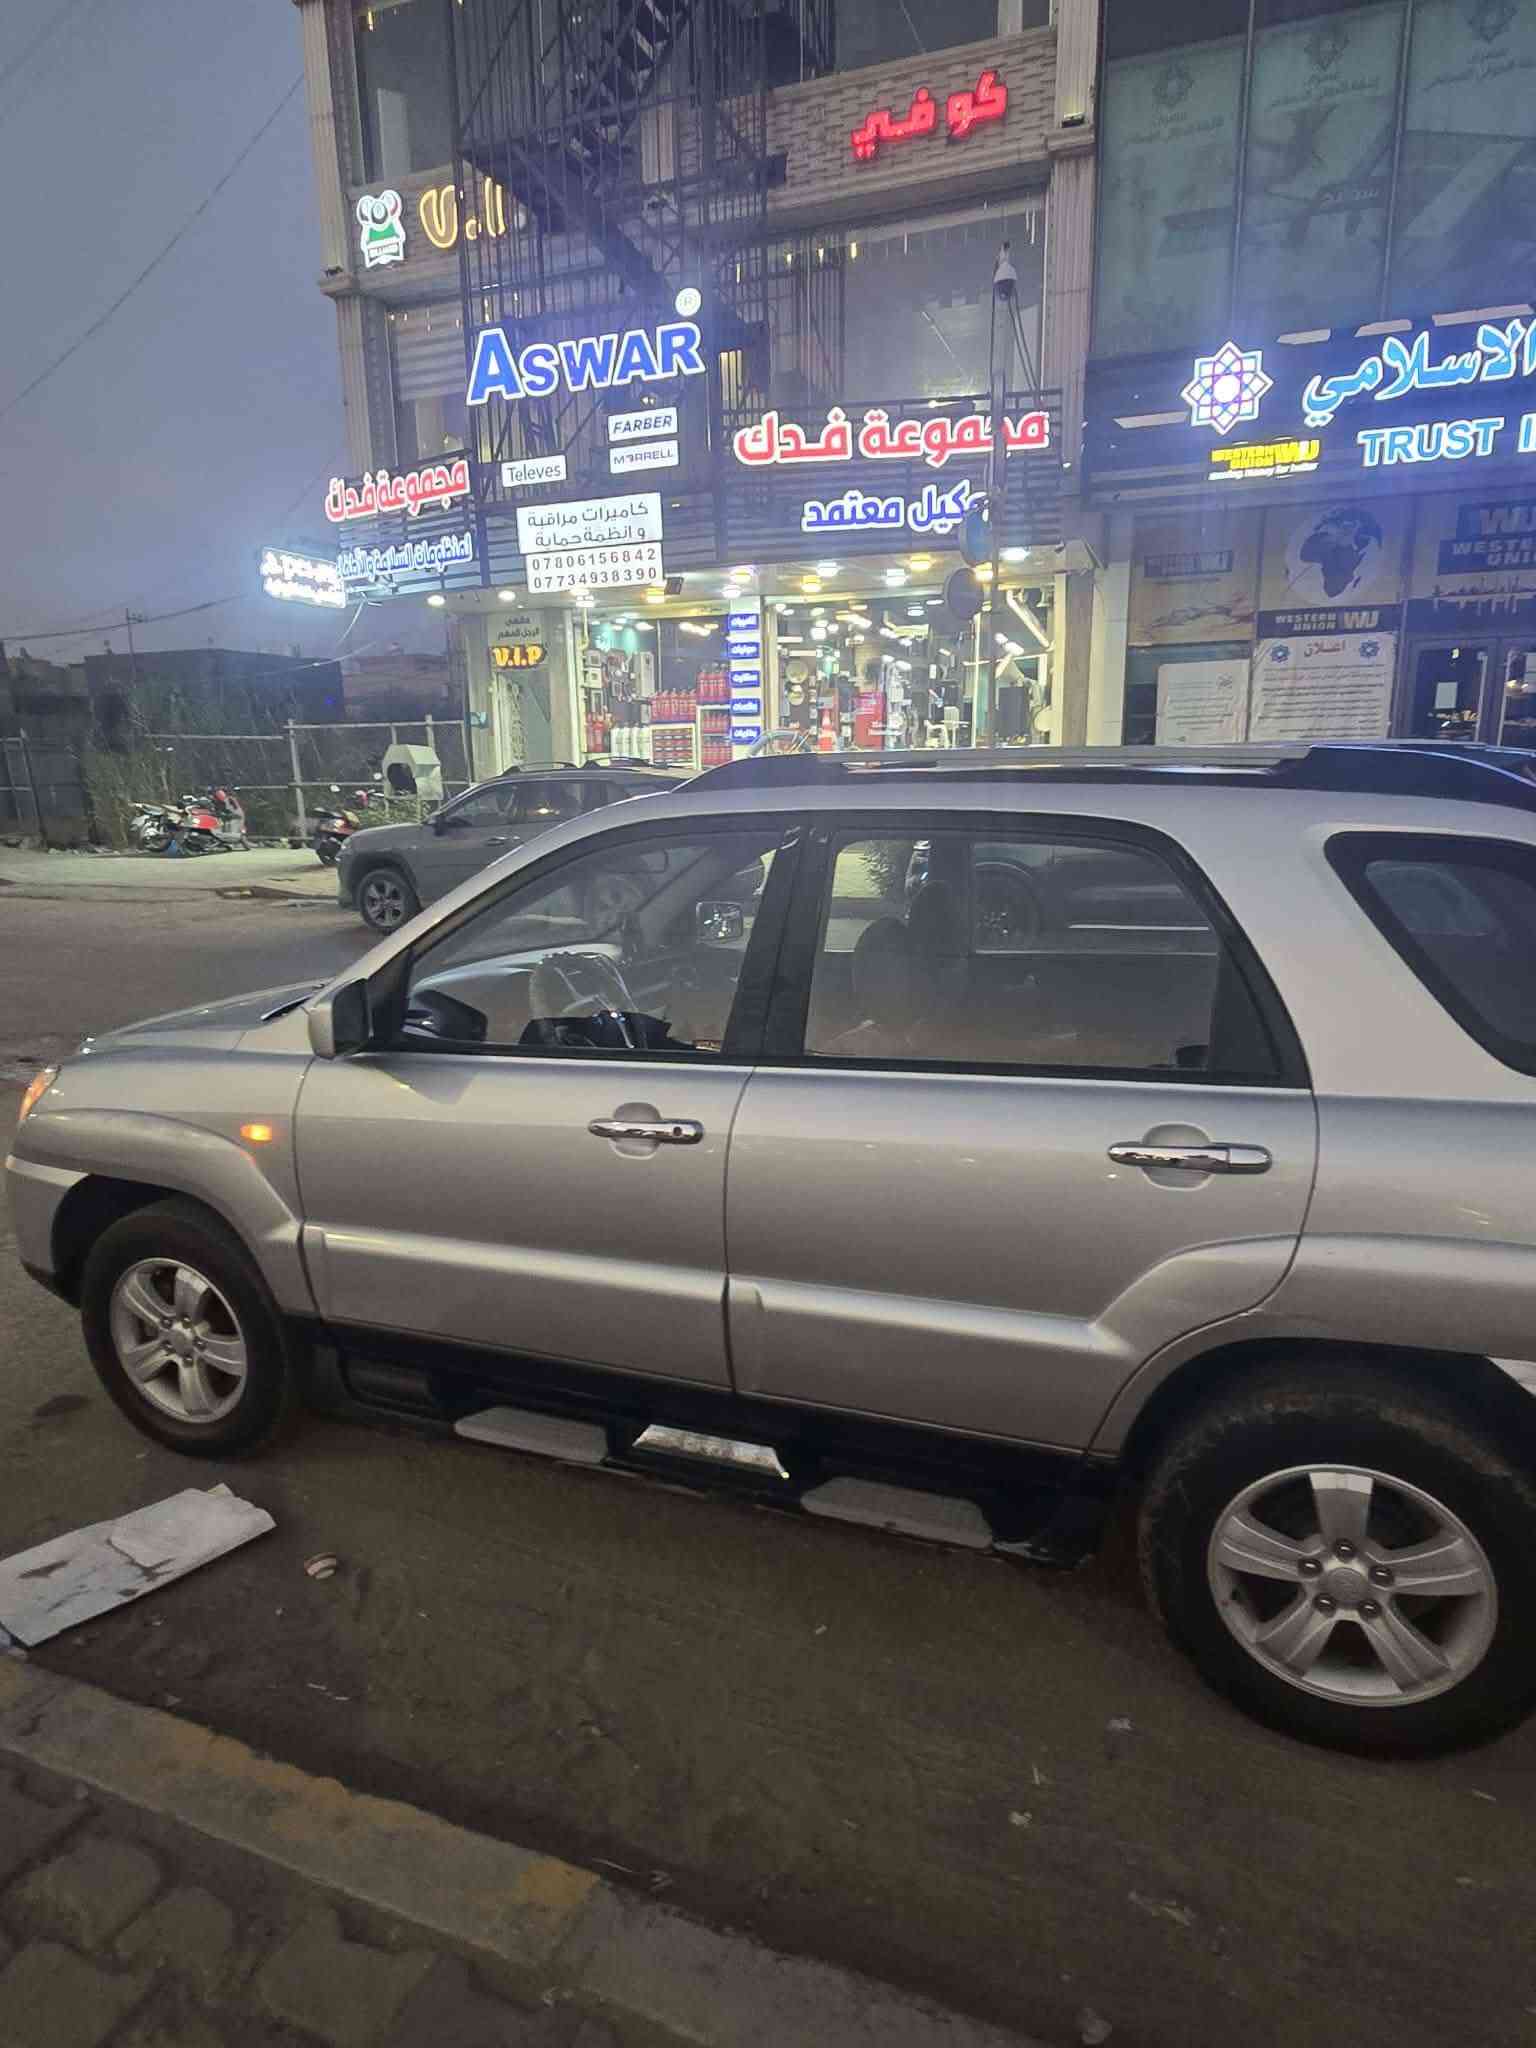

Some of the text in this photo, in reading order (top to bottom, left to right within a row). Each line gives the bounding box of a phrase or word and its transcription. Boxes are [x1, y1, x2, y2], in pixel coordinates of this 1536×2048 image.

[613, 415, 672, 434] FARBER
[734, 406, 853, 465] فدك
[1357, 416, 1504, 467] TRUST
[507, 463, 561, 482] Televes
[325, 460, 470, 522] مجموعة فدك
[528, 500, 649, 528] كاميرات مراقبة
[802, 489, 905, 533] معتمد
[535, 531, 582, 550] حماية
[532, 549, 656, 571] 07806156842
[533, 567, 657, 589] 07734938390
[1275, 611, 1337, 624] WESTERN
